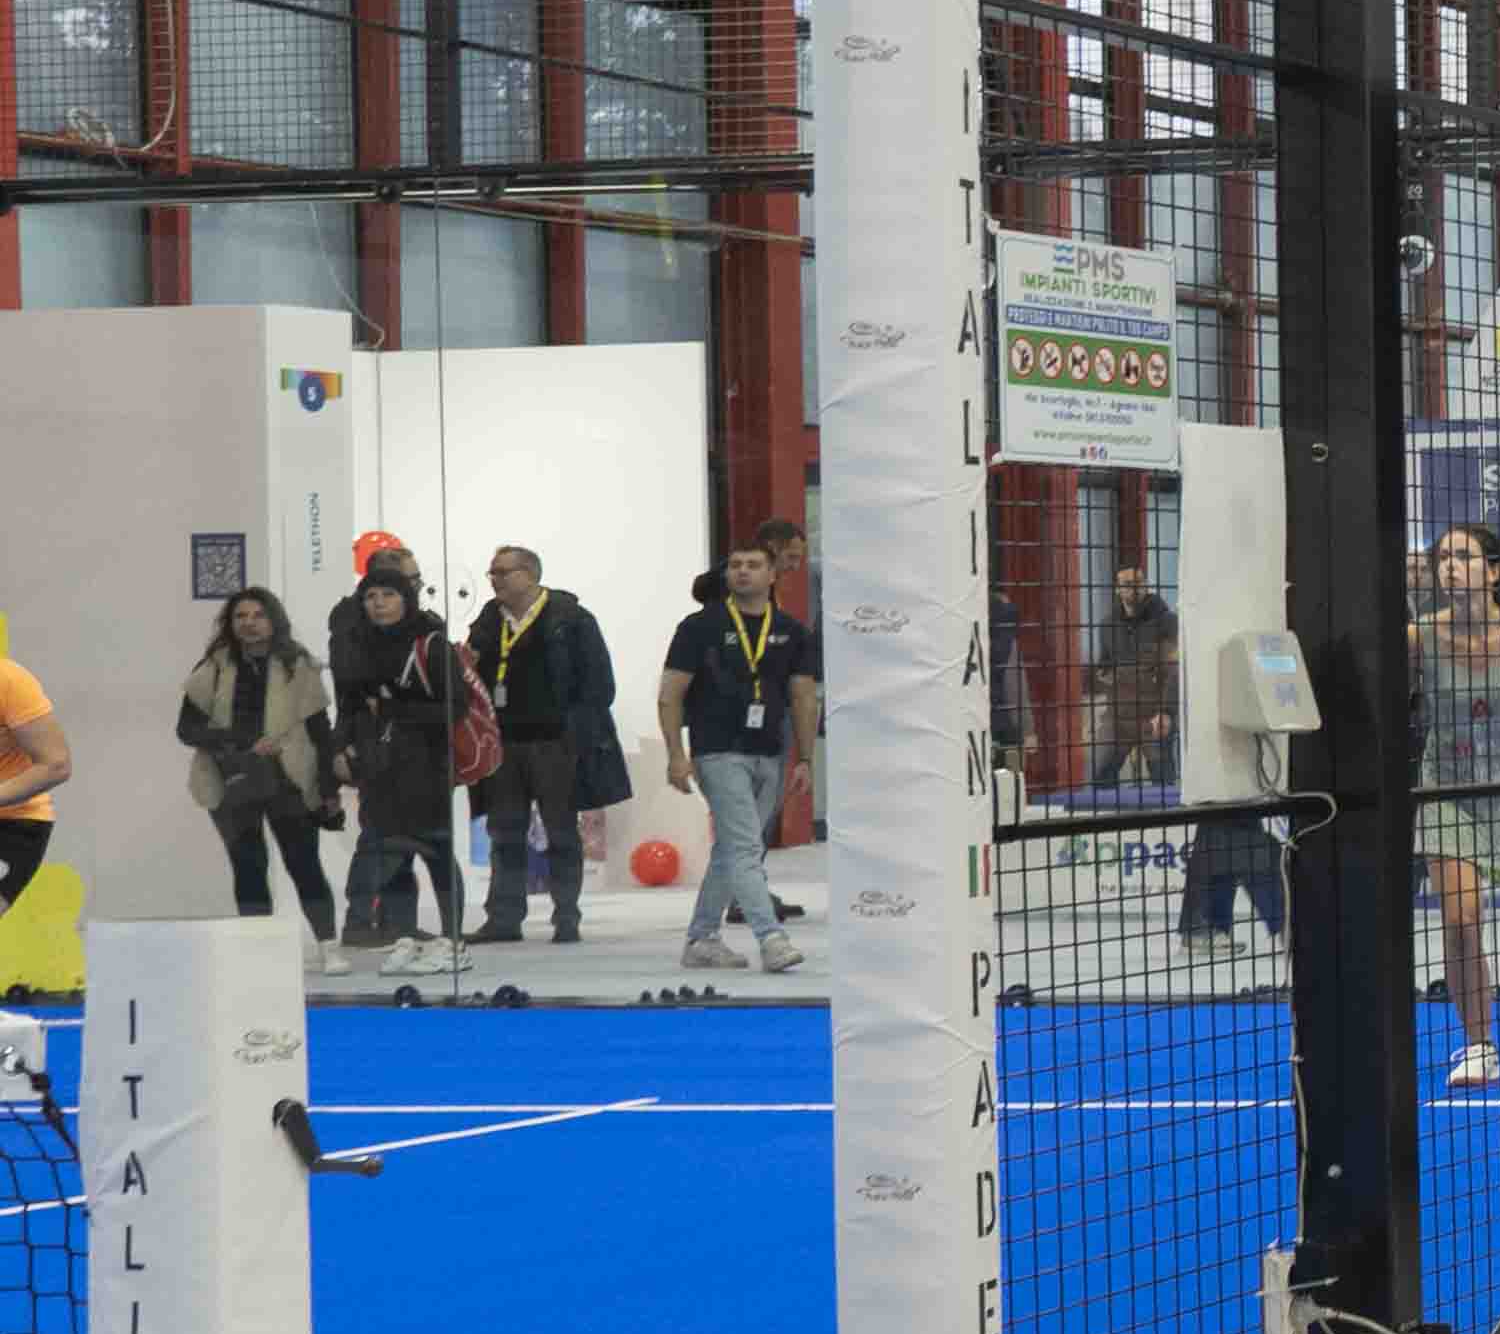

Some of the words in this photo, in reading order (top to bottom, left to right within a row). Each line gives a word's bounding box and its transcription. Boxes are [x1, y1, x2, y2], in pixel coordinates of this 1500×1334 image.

[1076, 248, 1125, 282] PMS
[1021, 273, 1087, 296] IMPIANTI
[1093, 283, 1157, 306] SPORTIVI
[957, 67, 988, 797] ITALIAN
